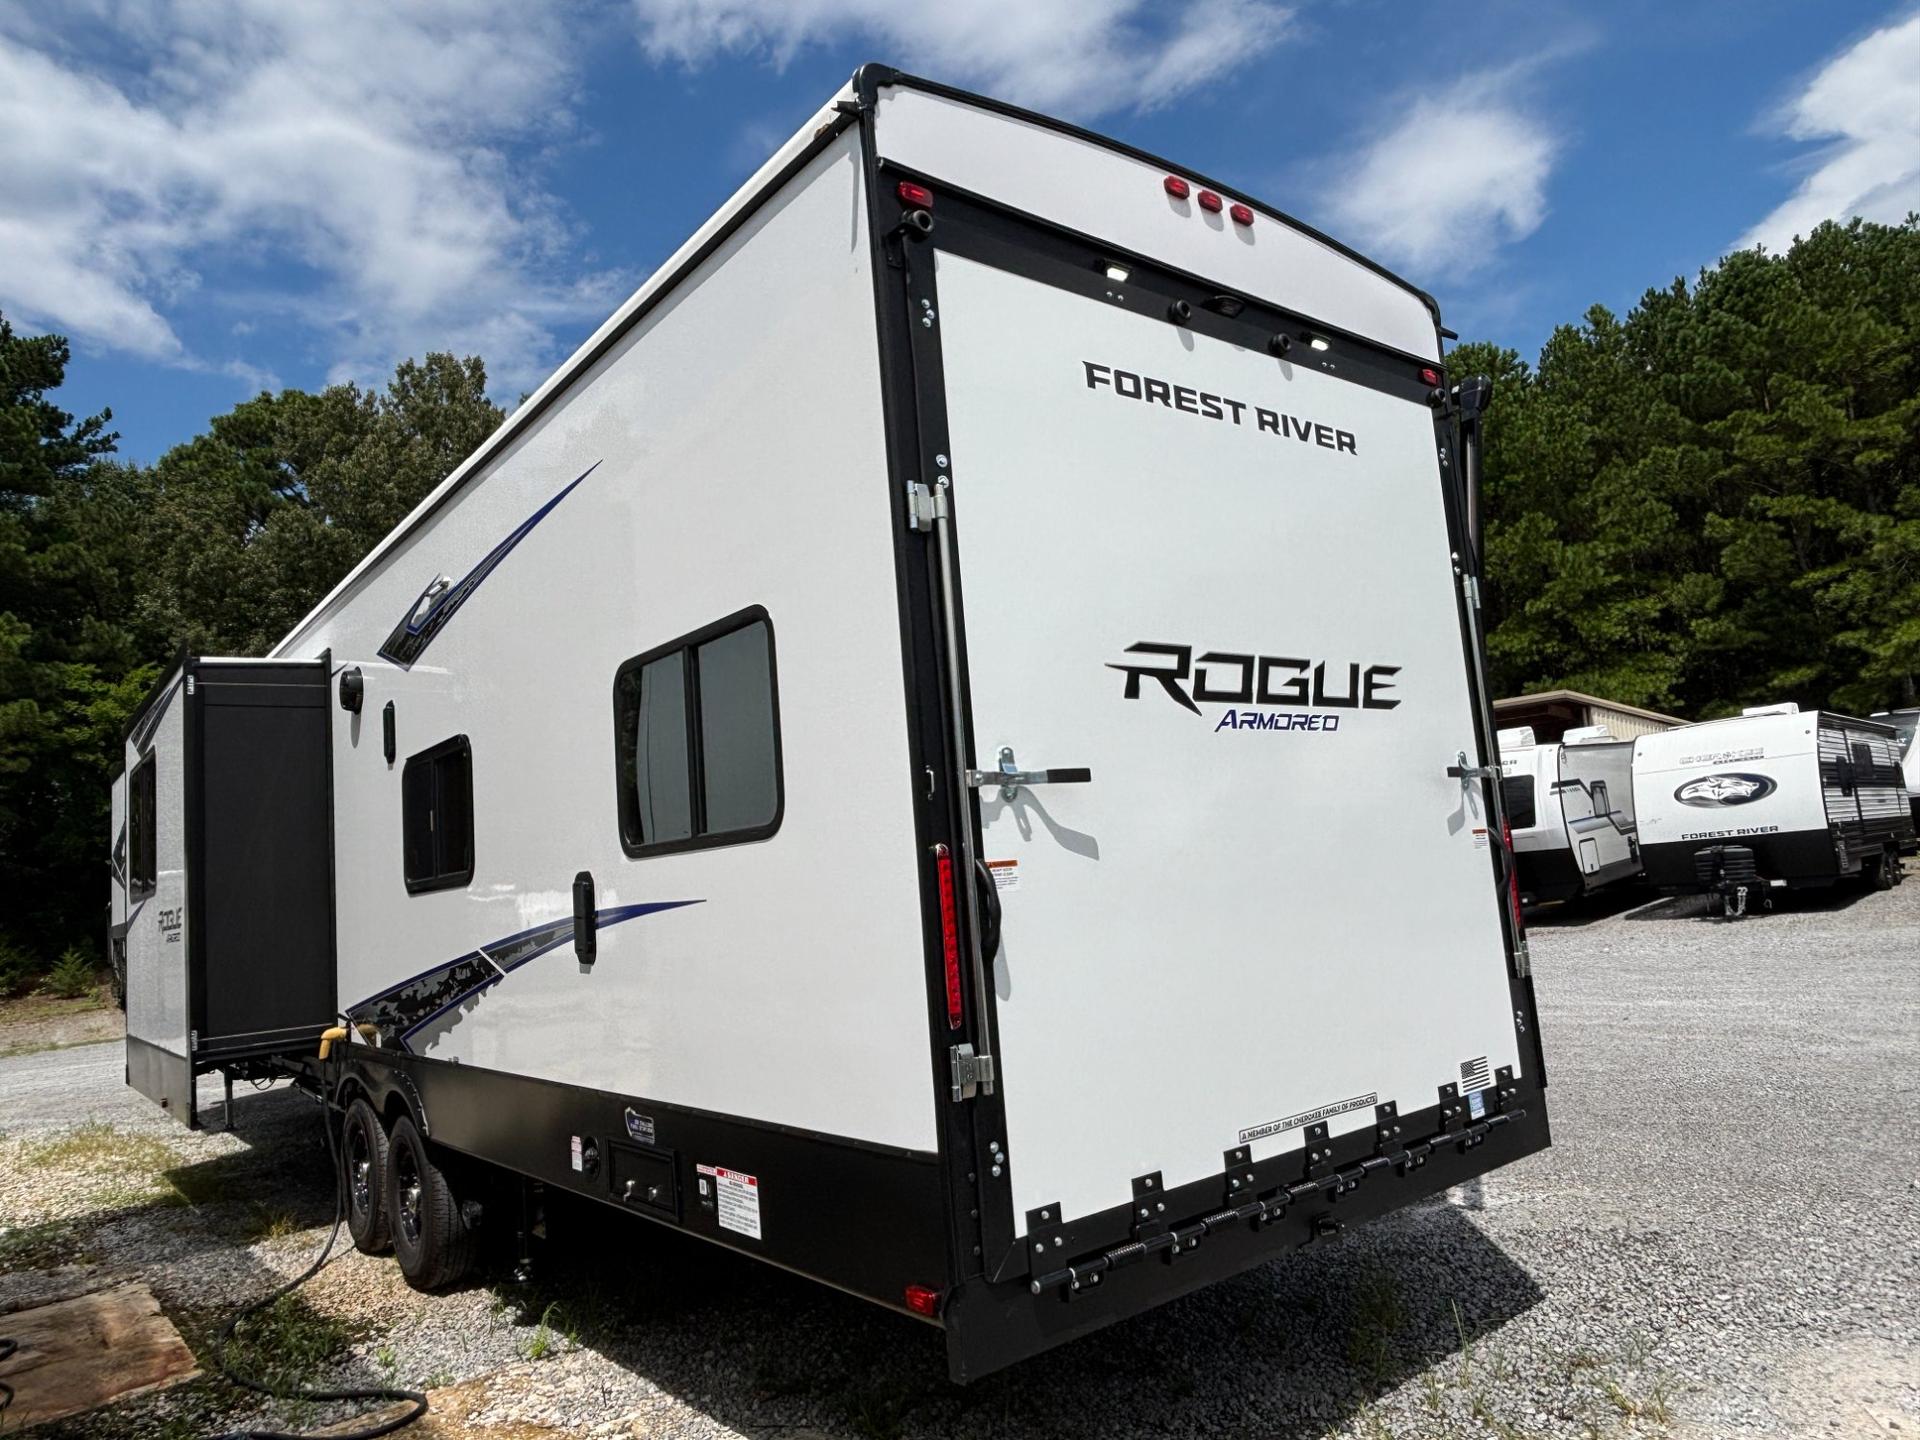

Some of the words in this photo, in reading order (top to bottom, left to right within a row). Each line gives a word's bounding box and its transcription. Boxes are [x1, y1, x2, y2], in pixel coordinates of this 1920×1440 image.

[1082, 361, 1247, 425] FOREST
[1254, 406, 1358, 456] RIVER
[1104, 641, 1402, 717] ROGUE
[1214, 709, 1340, 732] ARMORED
[1681, 829, 1734, 840] FOREST
[1736, 825, 1779, 836] RIVER
[1241, 1132, 1247, 1140] A
[1247, 1126, 1272, 1139] MEMBER
[1273, 1123, 1281, 1132] OF
[1282, 1119, 1293, 1129] THE
[1322, 1105, 1341, 1117] FAMILY
